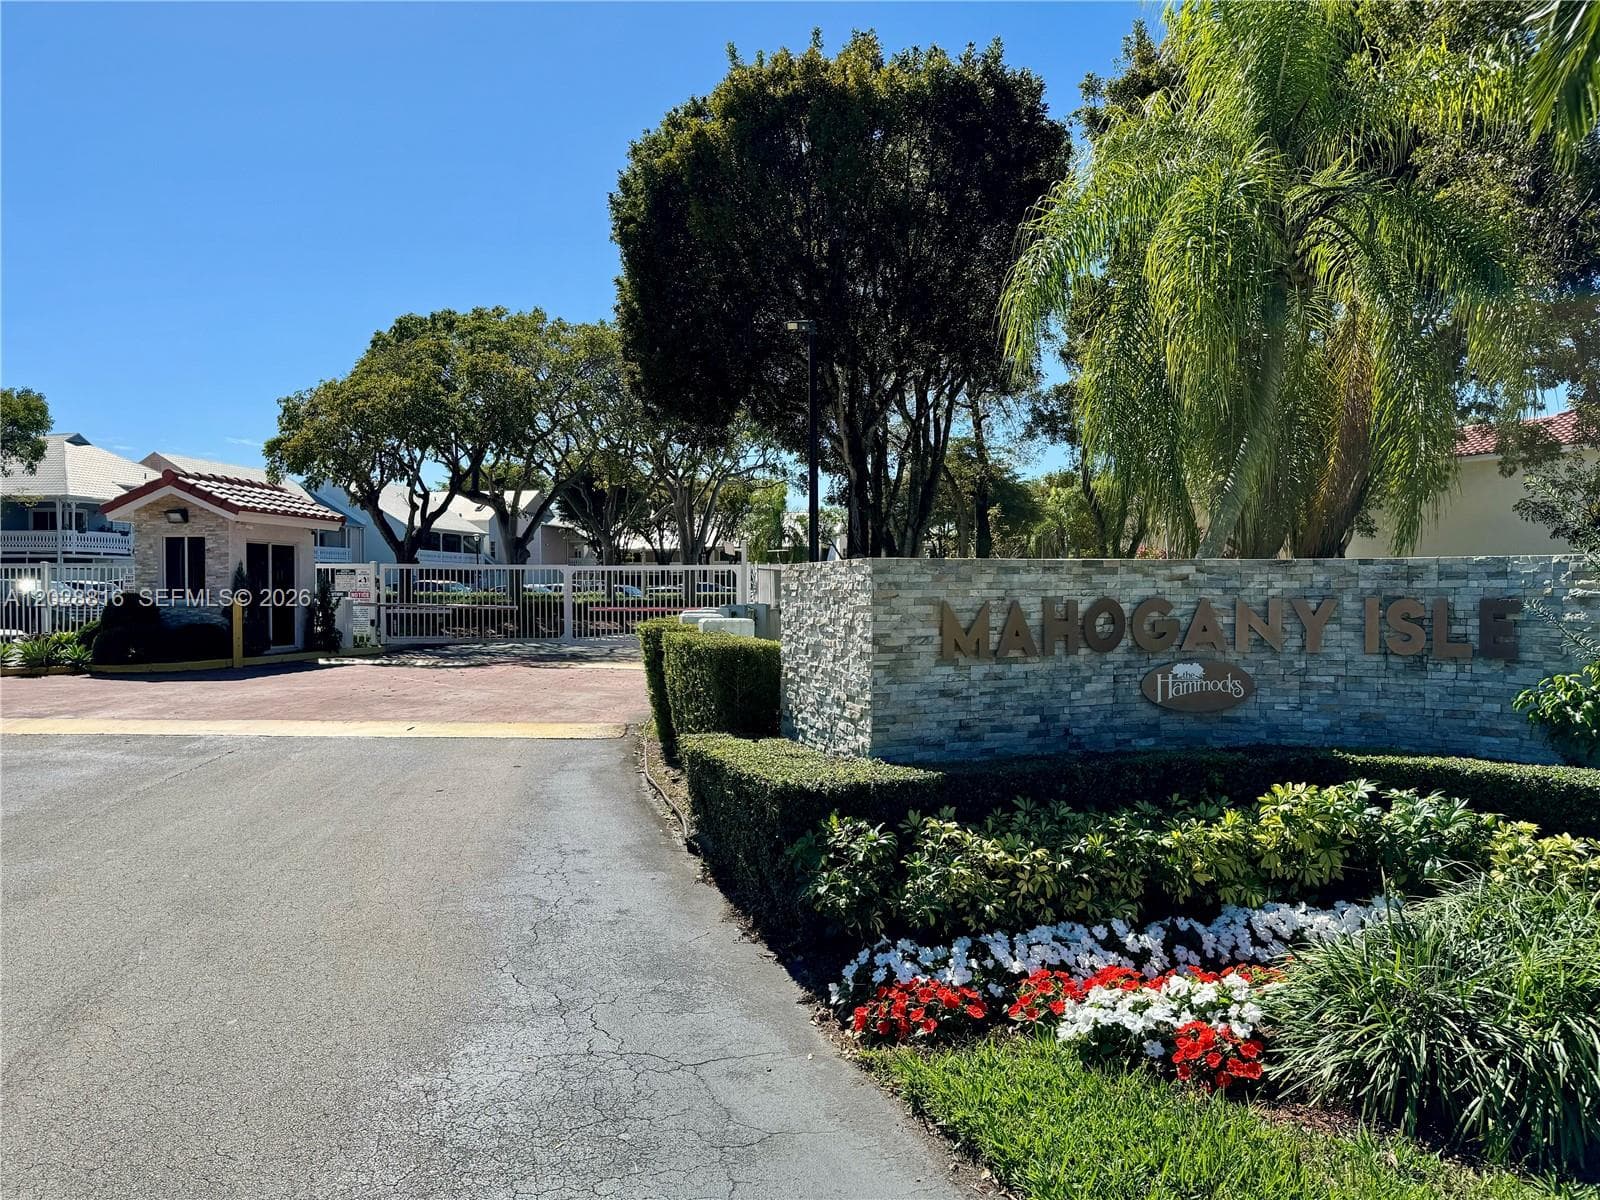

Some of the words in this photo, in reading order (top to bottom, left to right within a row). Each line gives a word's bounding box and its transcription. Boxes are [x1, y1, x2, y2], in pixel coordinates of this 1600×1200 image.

[941, 597, 1338, 660] MAHOGANY
[1365, 597, 1520, 659] ISLE
[1156, 673, 1244, 703] Hammocks
